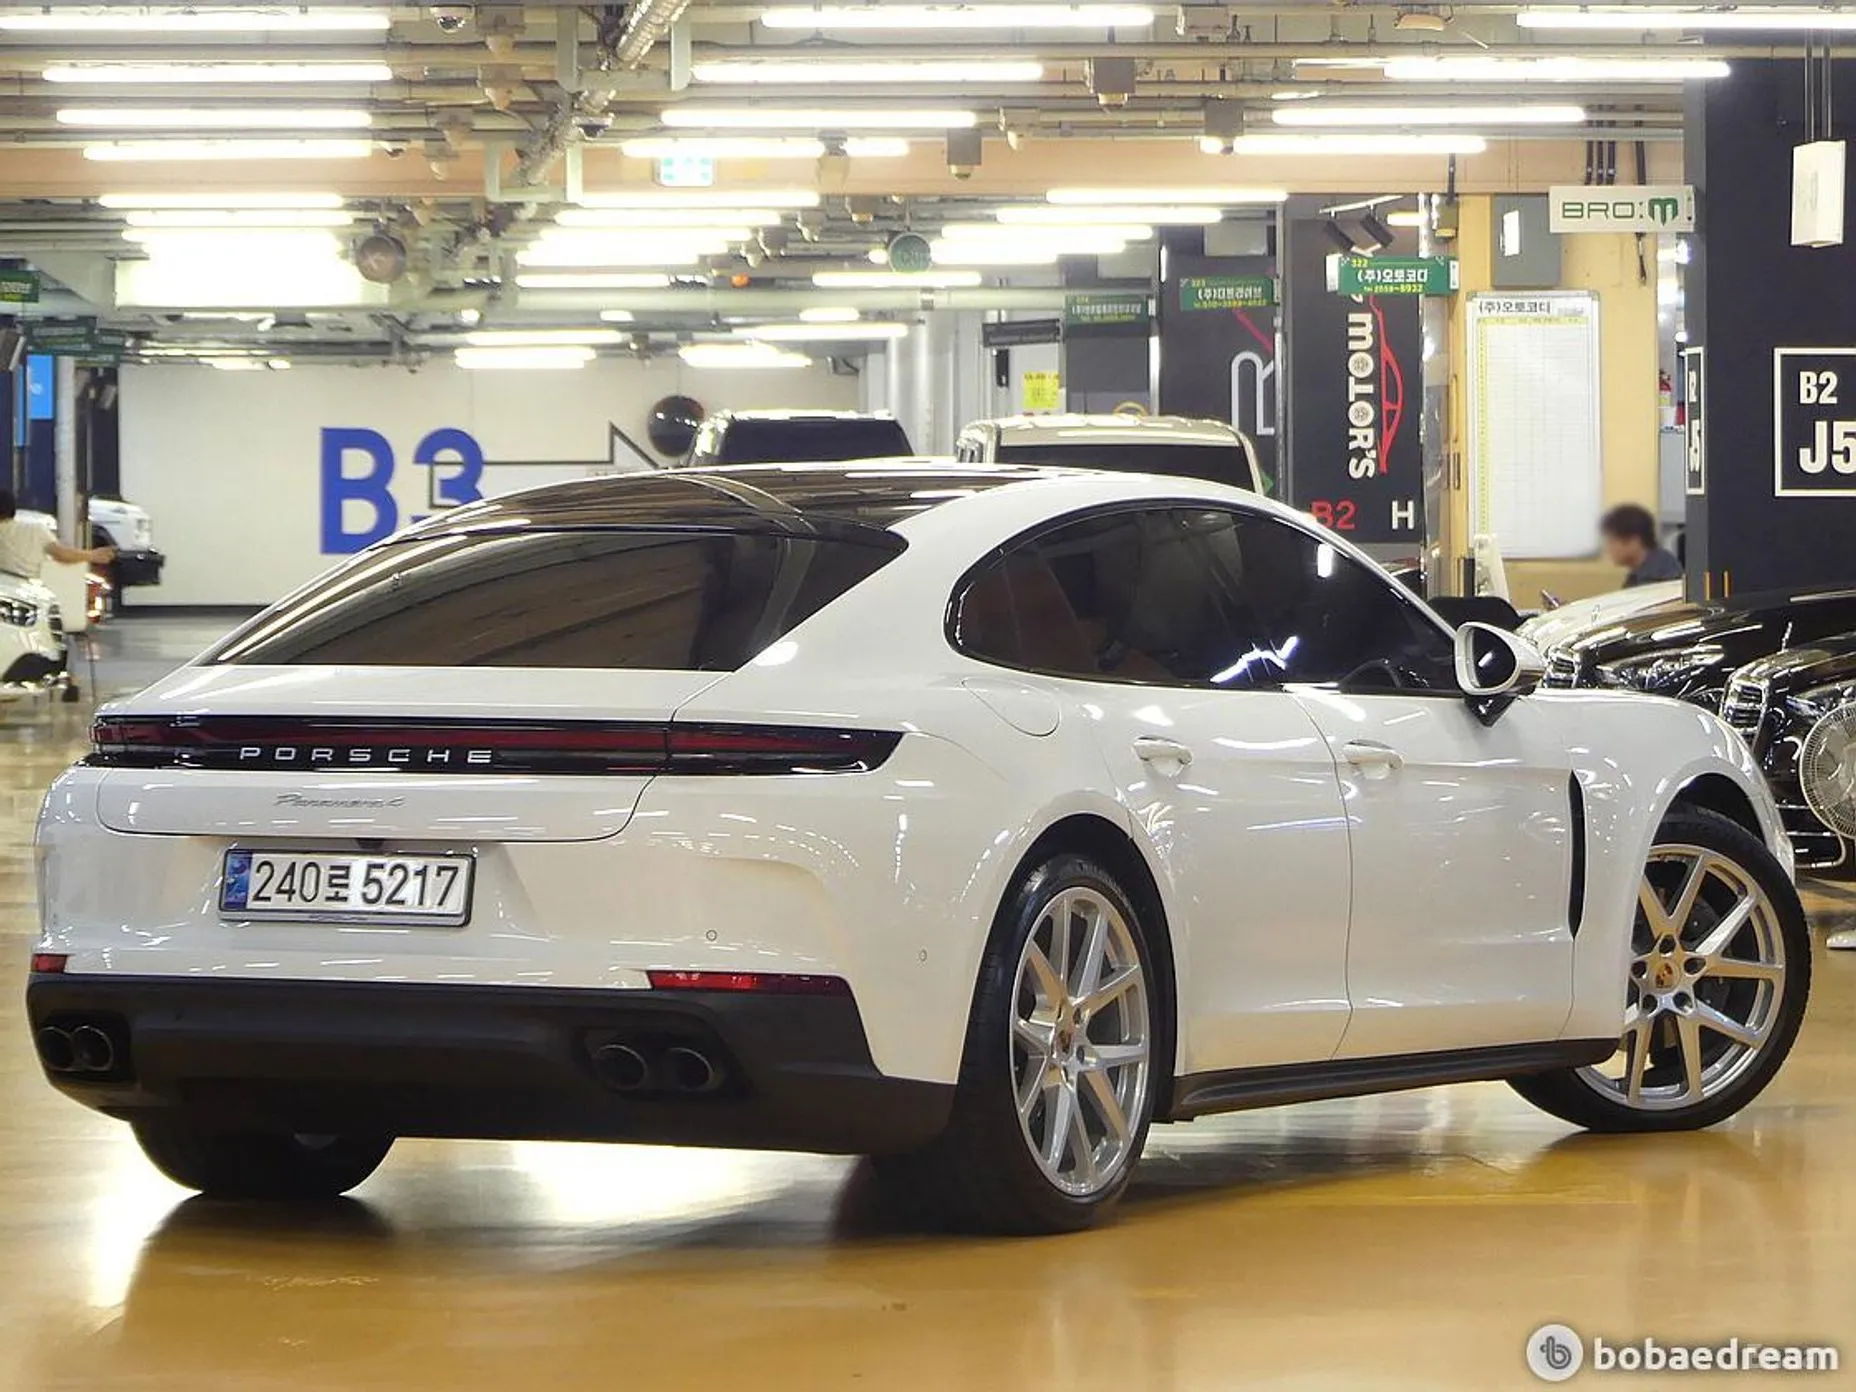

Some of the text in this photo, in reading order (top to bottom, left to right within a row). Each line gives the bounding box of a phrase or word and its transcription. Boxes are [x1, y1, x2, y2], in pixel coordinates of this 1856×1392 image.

[1800, 371, 1838, 404] B2
[1799, 420, 1856, 474] J5
[1311, 501, 1356, 529] B2
[1392, 501, 1415, 530] H
[239, 747, 492, 764] PORSCHE
[252, 860, 459, 907] 240로 5217
